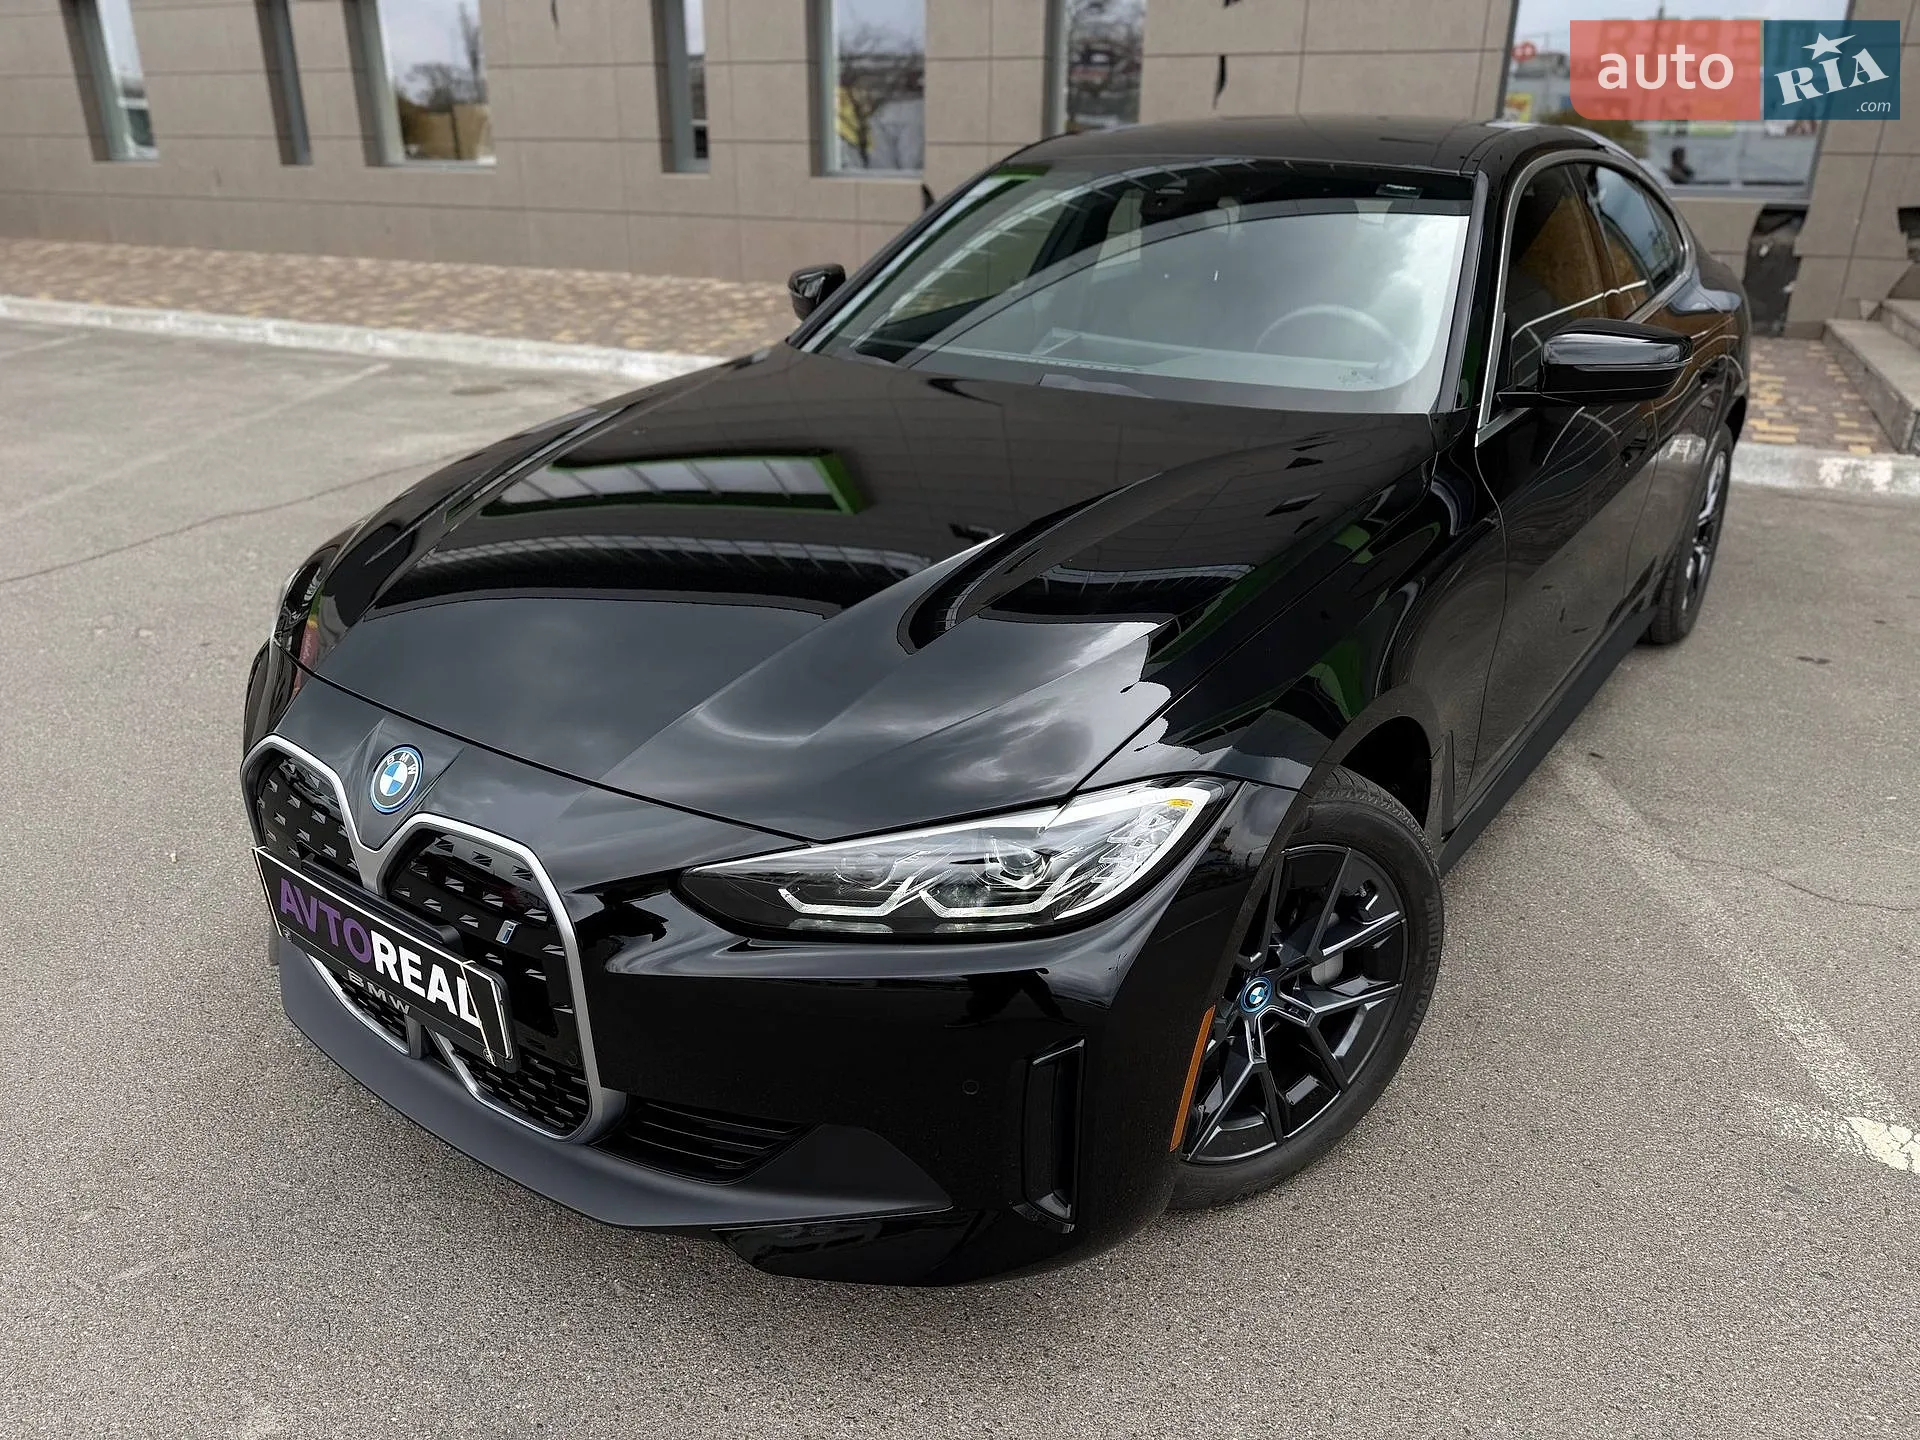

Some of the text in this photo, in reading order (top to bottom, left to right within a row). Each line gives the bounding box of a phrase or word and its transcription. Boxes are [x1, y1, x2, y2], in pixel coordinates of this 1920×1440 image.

[386, 752, 417, 775] BMW
[279, 877, 483, 1029] AVTOREAL
[346, 969, 412, 1015] BMW
